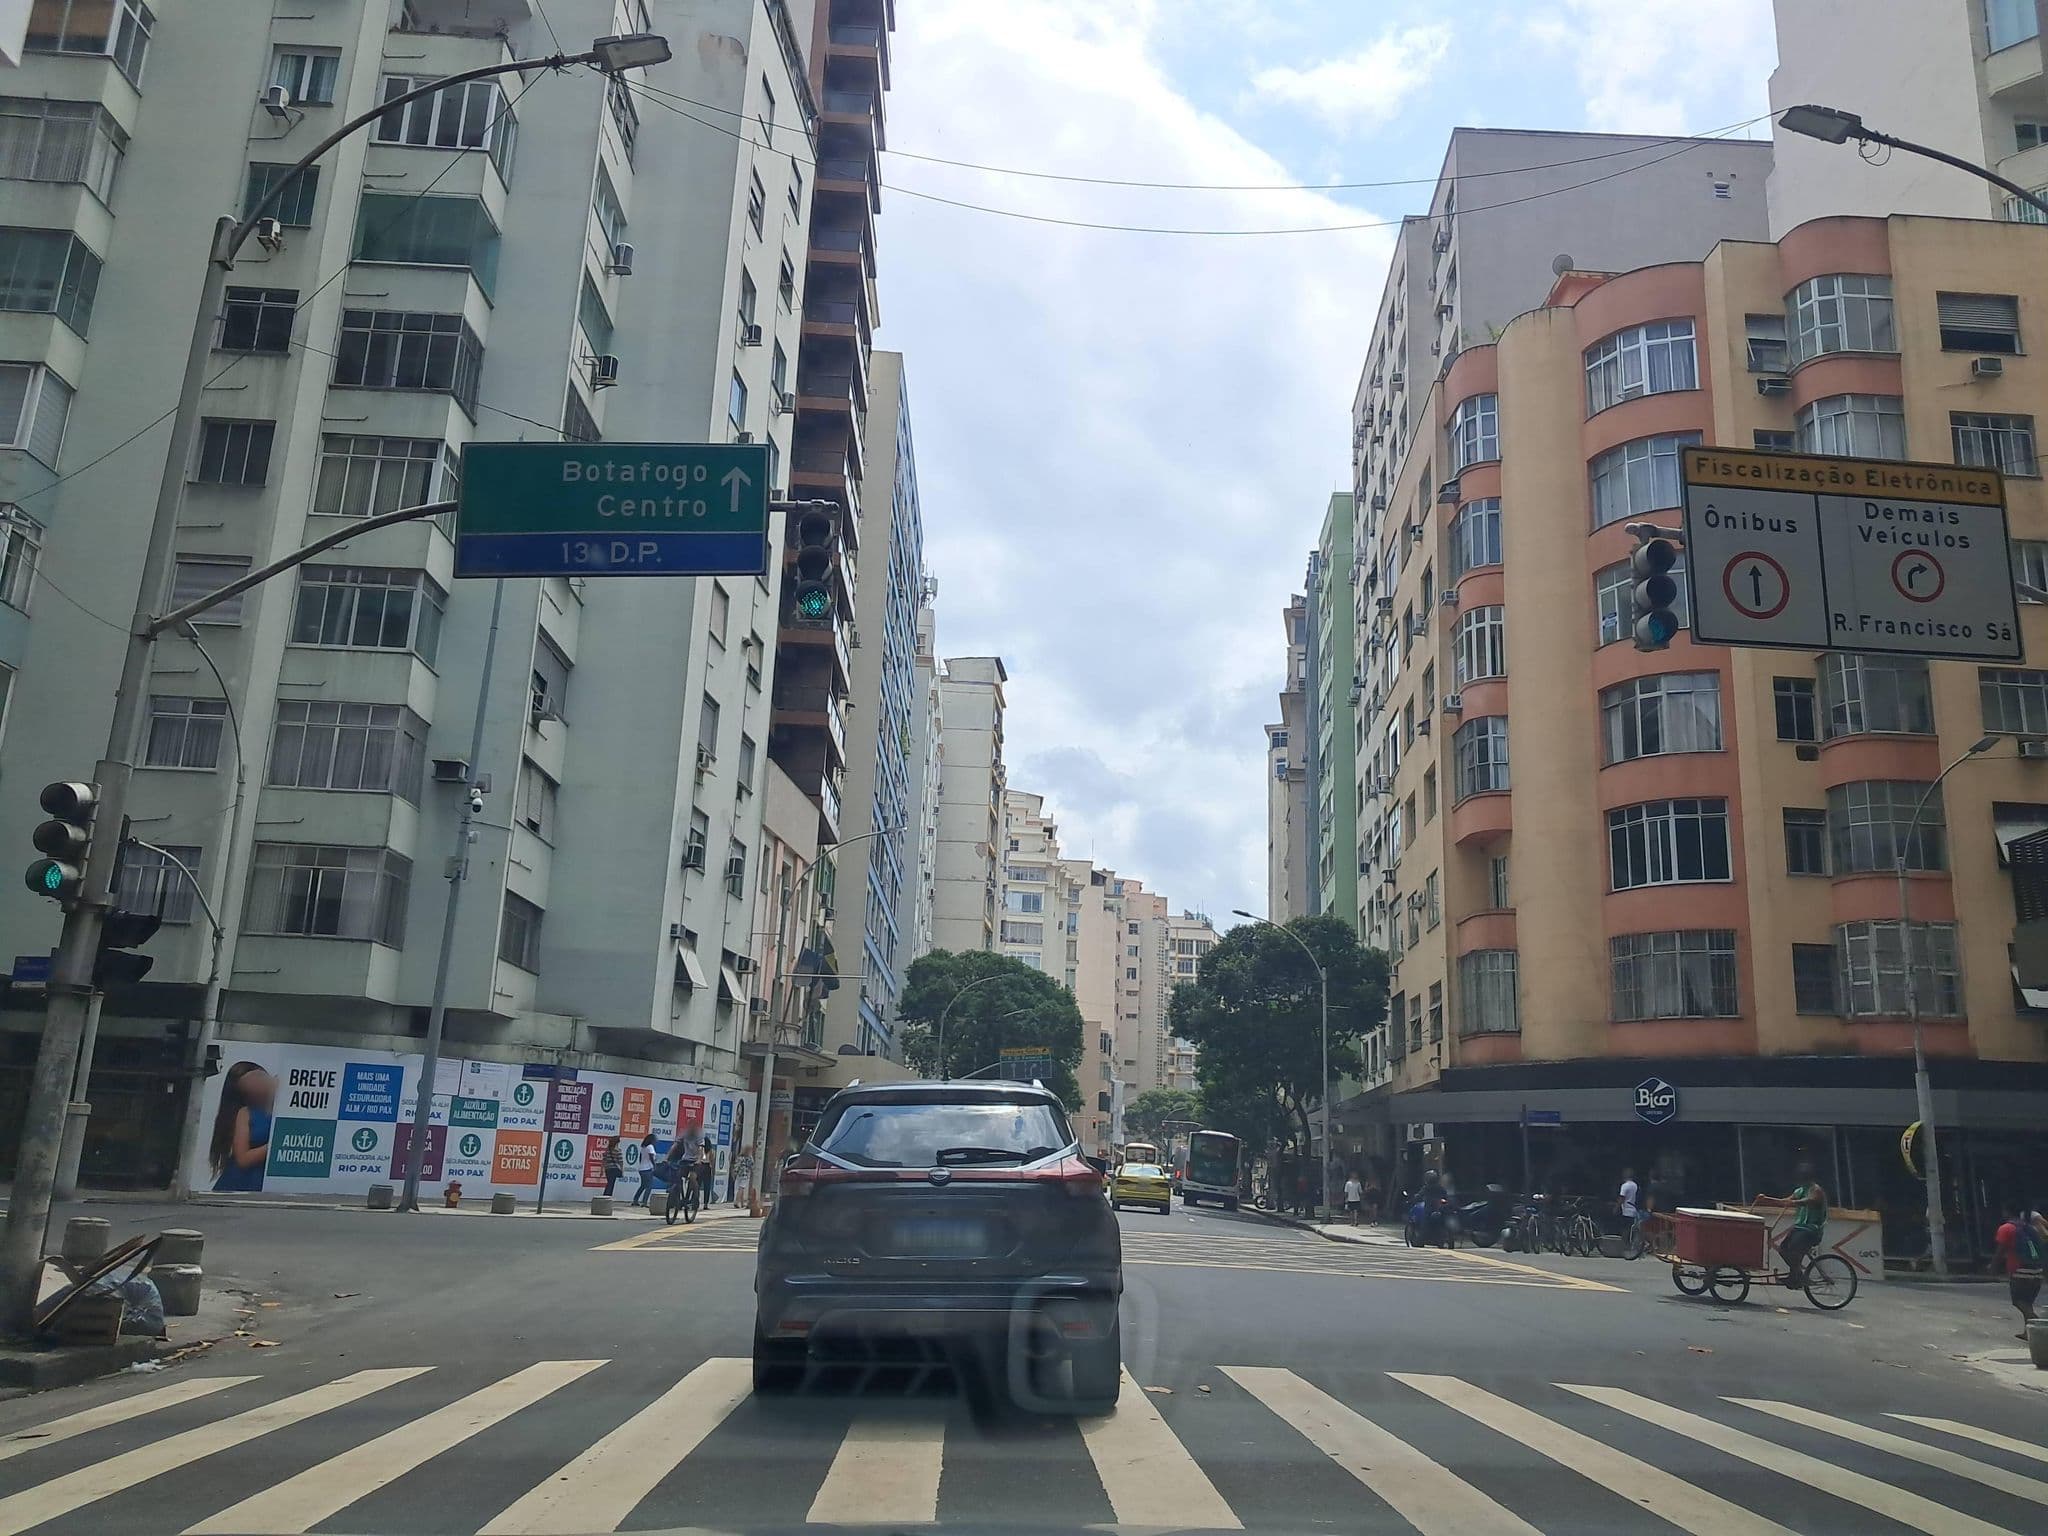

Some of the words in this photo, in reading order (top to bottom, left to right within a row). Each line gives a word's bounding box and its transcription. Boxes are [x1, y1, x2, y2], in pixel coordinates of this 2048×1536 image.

[562, 461, 707, 490] Botafogo
[1696, 457, 1856, 488] Fiscalização
[1866, 470, 1991, 495] Eletrônica
[597, 495, 706, 517] Centro
[1865, 502, 1960, 525] Demais
[1704, 504, 1798, 534] Ônibus
[1858, 525, 1970, 549] Veículos
[610, 541, 662, 563] D.P.
[1834, 613, 1853, 632] R.
[1859, 615, 1973, 638] Francisco
[1986, 622, 2012, 641] Sá
[289, 1069, 337, 1088] BREVE
[356, 1071, 374, 1081] MAIS
[375, 1073, 391, 1082] UMA
[357, 1083, 387, 1093] UNIDADE
[289, 1090, 330, 1109] AQUI!
[348, 1093, 392, 1104] SEGURADORA
[463, 1100, 487, 1111] AUXÍLIO
[1636, 1088, 1674, 1108] Bico
[345, 1104, 360, 1113] ALM
[367, 1105, 378, 1114] RIO
[379, 1106, 393, 1115] PAX
[453, 1109, 495, 1122] ALIMENTAÇÃO
[503, 1116, 519, 1125] RIO
[520, 1117, 537, 1126] PAX
[282, 1133, 324, 1149] AUXÍLIO
[276, 1149, 324, 1164] MORADIA
[498, 1144, 537, 1157] DESPESAS
[338, 1164, 357, 1173] RIO
[360, 1165, 382, 1174] PAX
[501, 1157, 531, 1170] EXTRAS
[448, 1168, 464, 1176] RIO
[466, 1169, 485, 1177] PAX
[560, 1173, 577, 1181] PAX
